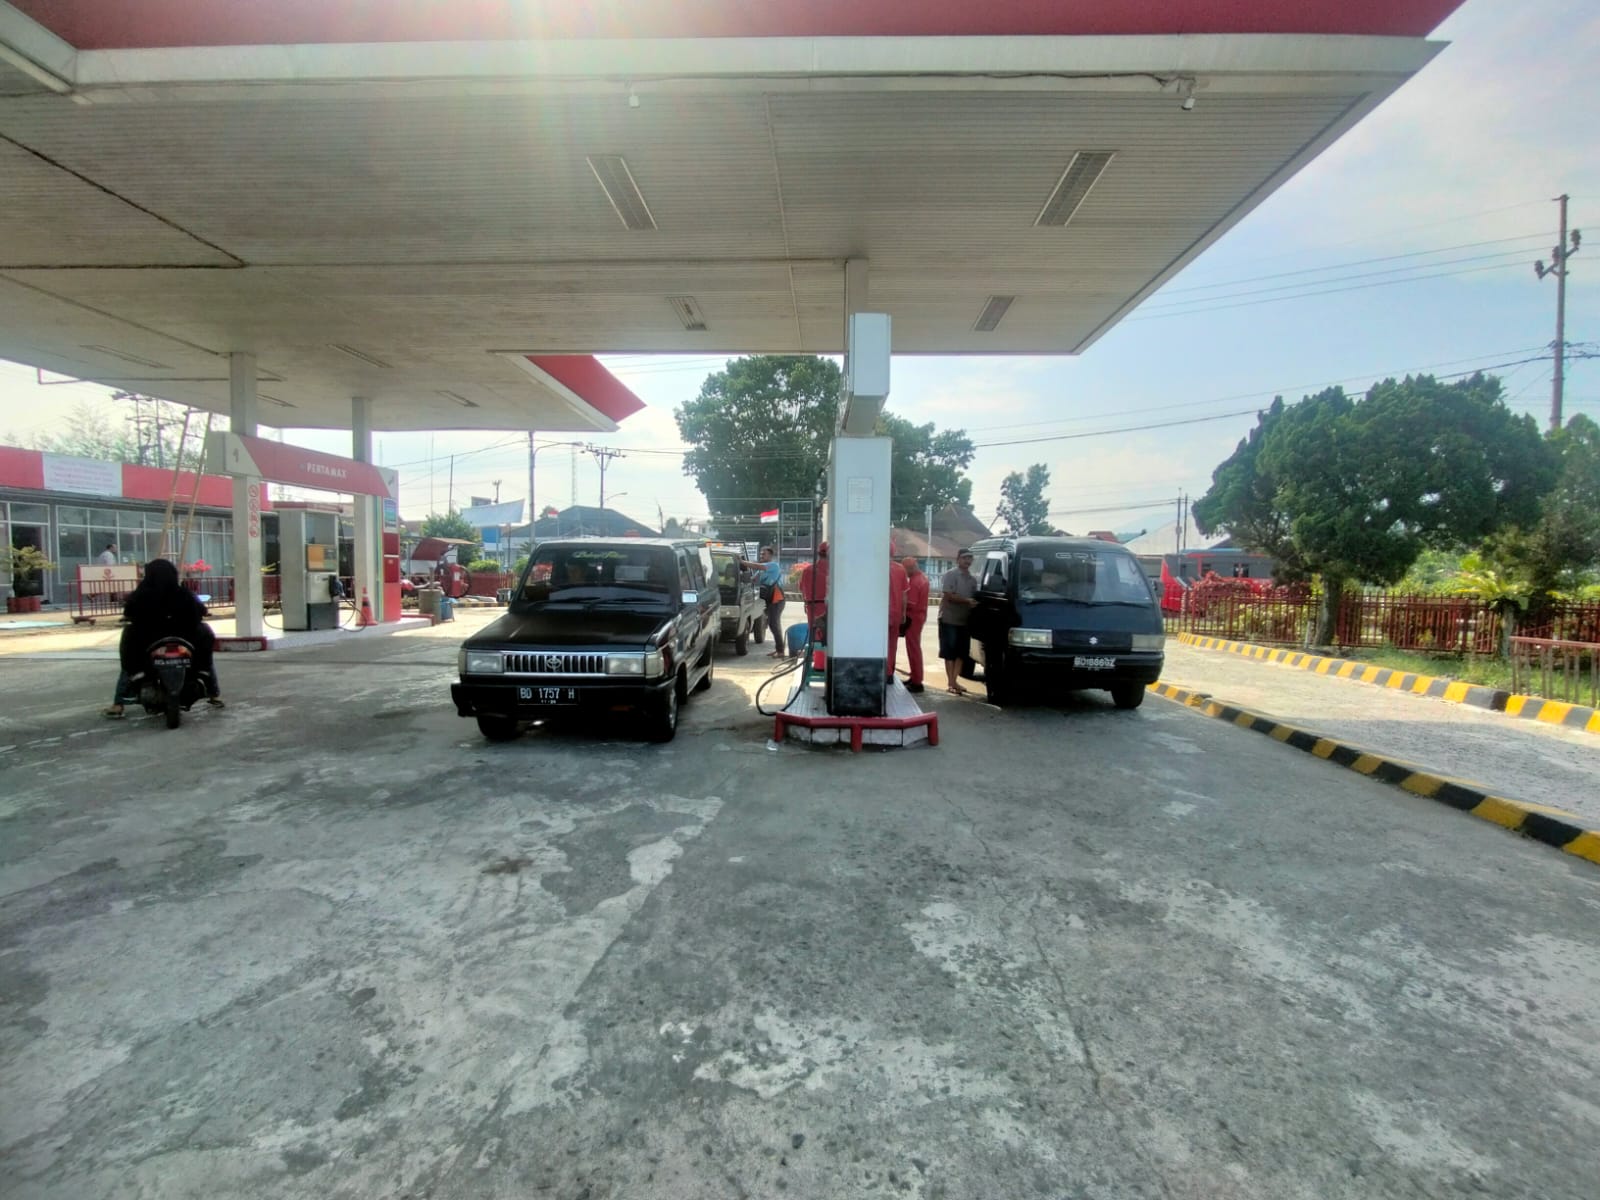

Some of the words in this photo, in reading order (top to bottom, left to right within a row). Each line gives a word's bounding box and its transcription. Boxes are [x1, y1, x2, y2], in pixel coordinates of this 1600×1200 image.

[306, 462, 347, 479] PERTAMAX
[520, 687, 532, 699] BD
[538, 687, 560, 699] 1757
[567, 687, 575, 699] H
